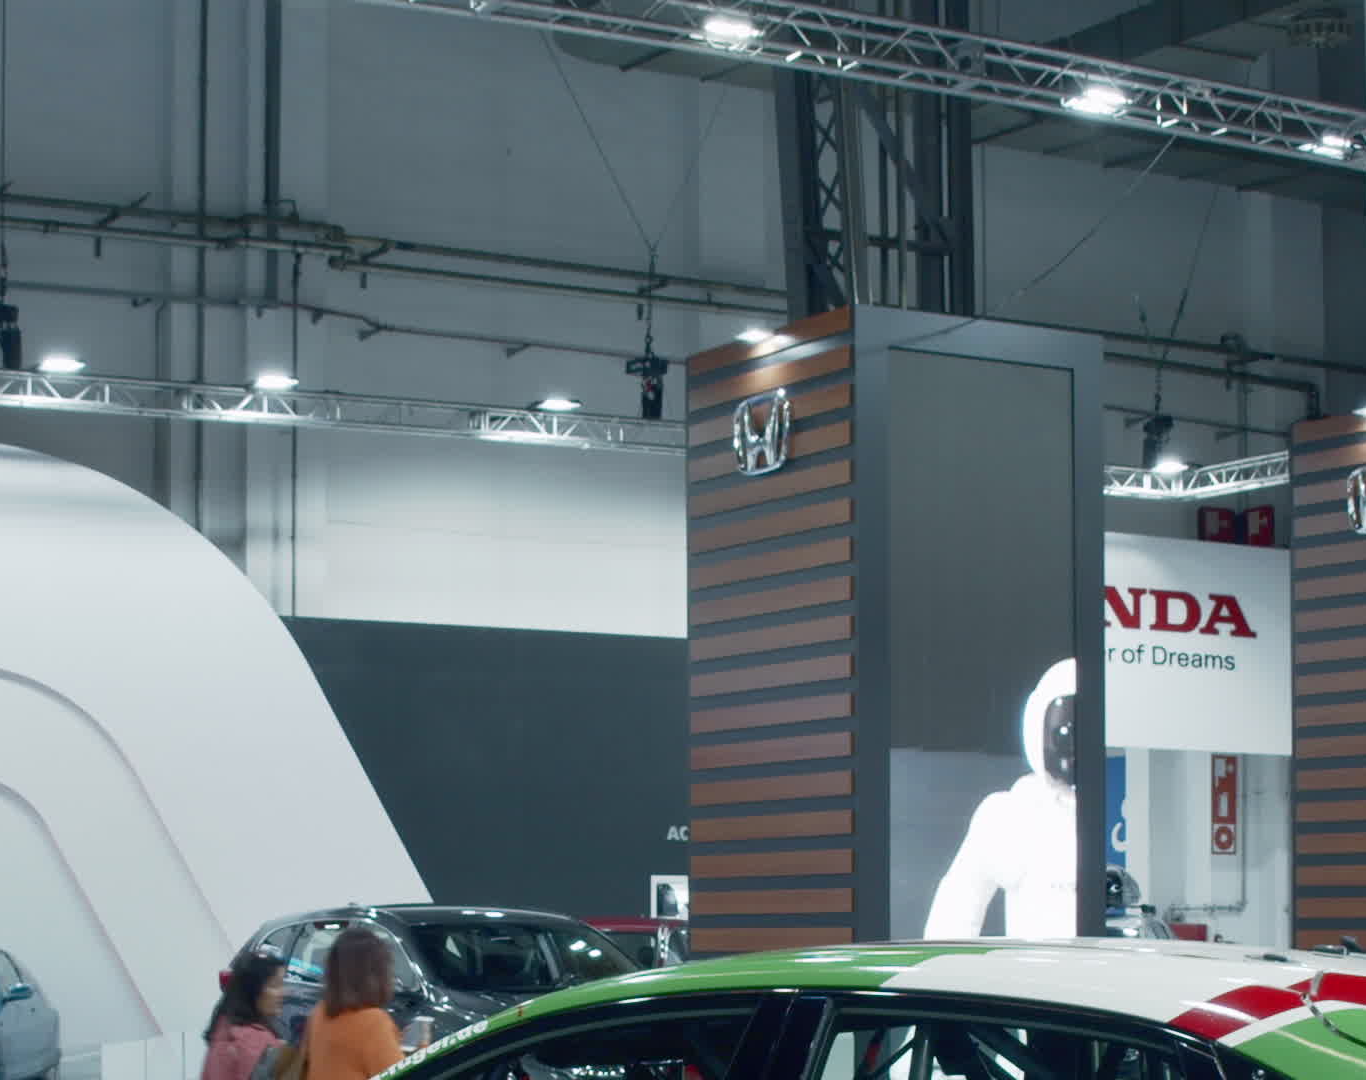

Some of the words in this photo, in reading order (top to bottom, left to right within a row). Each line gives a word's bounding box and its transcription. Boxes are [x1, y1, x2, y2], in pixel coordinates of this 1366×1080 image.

[1105, 585, 1258, 639] NDA
[1121, 644, 1146, 665] of
[1152, 645, 1237, 671] Dreams
